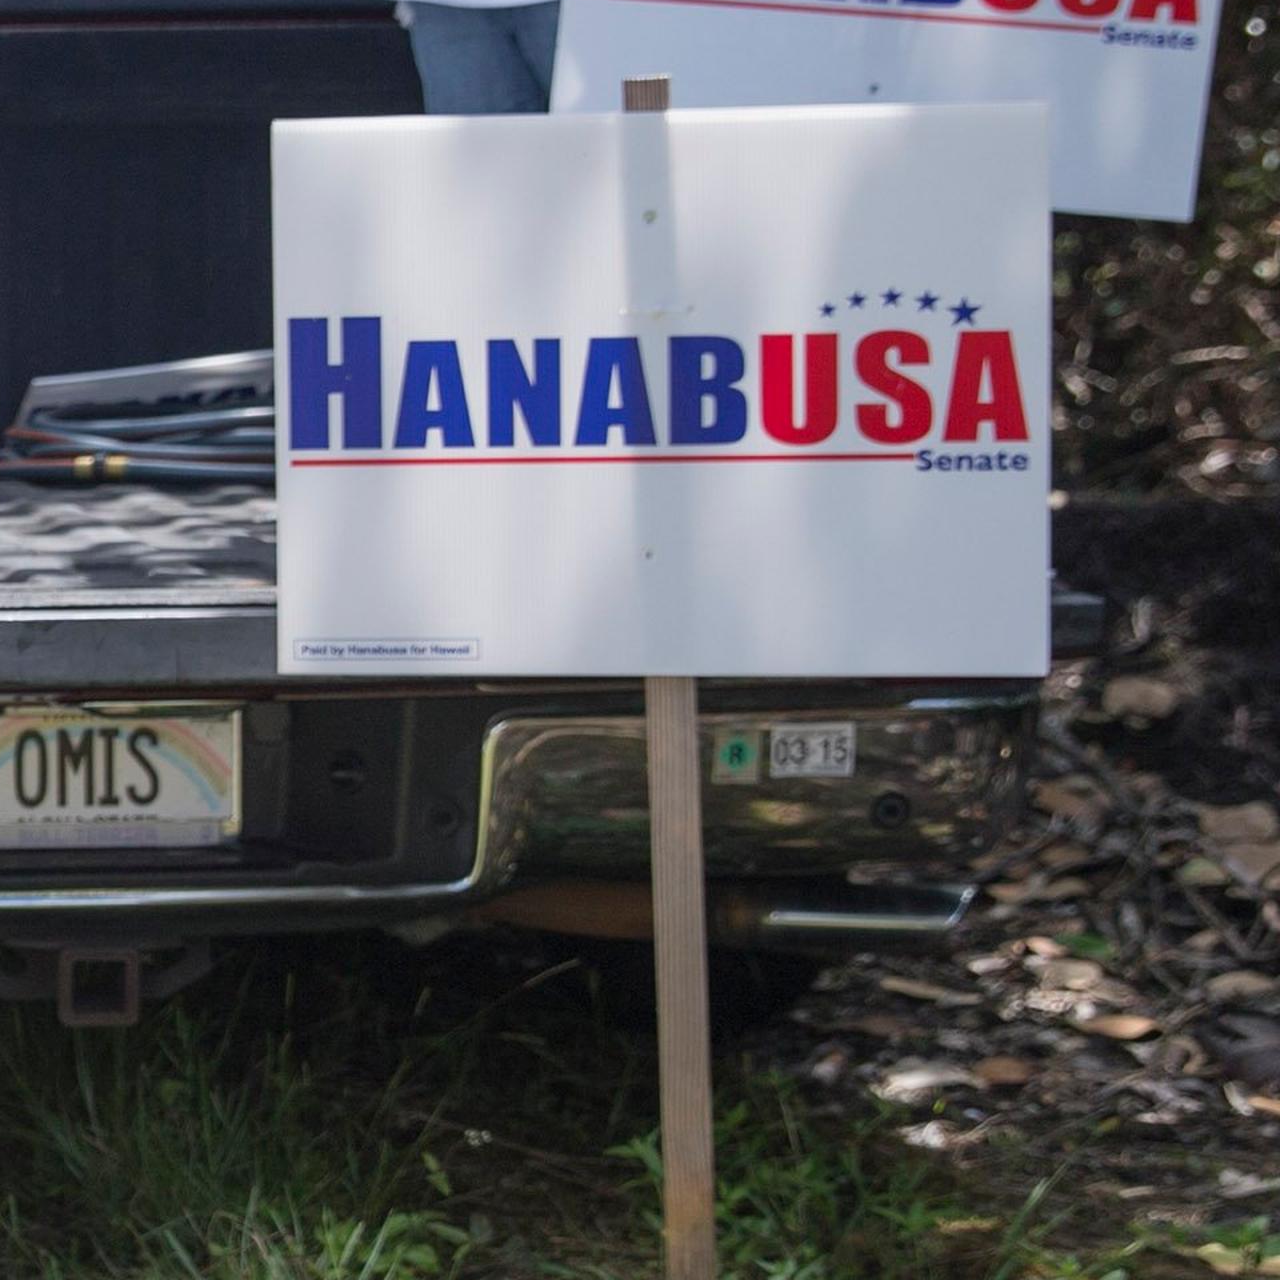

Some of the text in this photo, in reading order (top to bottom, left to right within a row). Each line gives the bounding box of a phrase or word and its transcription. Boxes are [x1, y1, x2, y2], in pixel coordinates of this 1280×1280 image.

[1103, 25, 1197, 50] Senate
[289, 316, 1030, 449] HANABUSA
[916, 449, 1030, 472] Senate
[13, 726, 160, 809] OMIS
